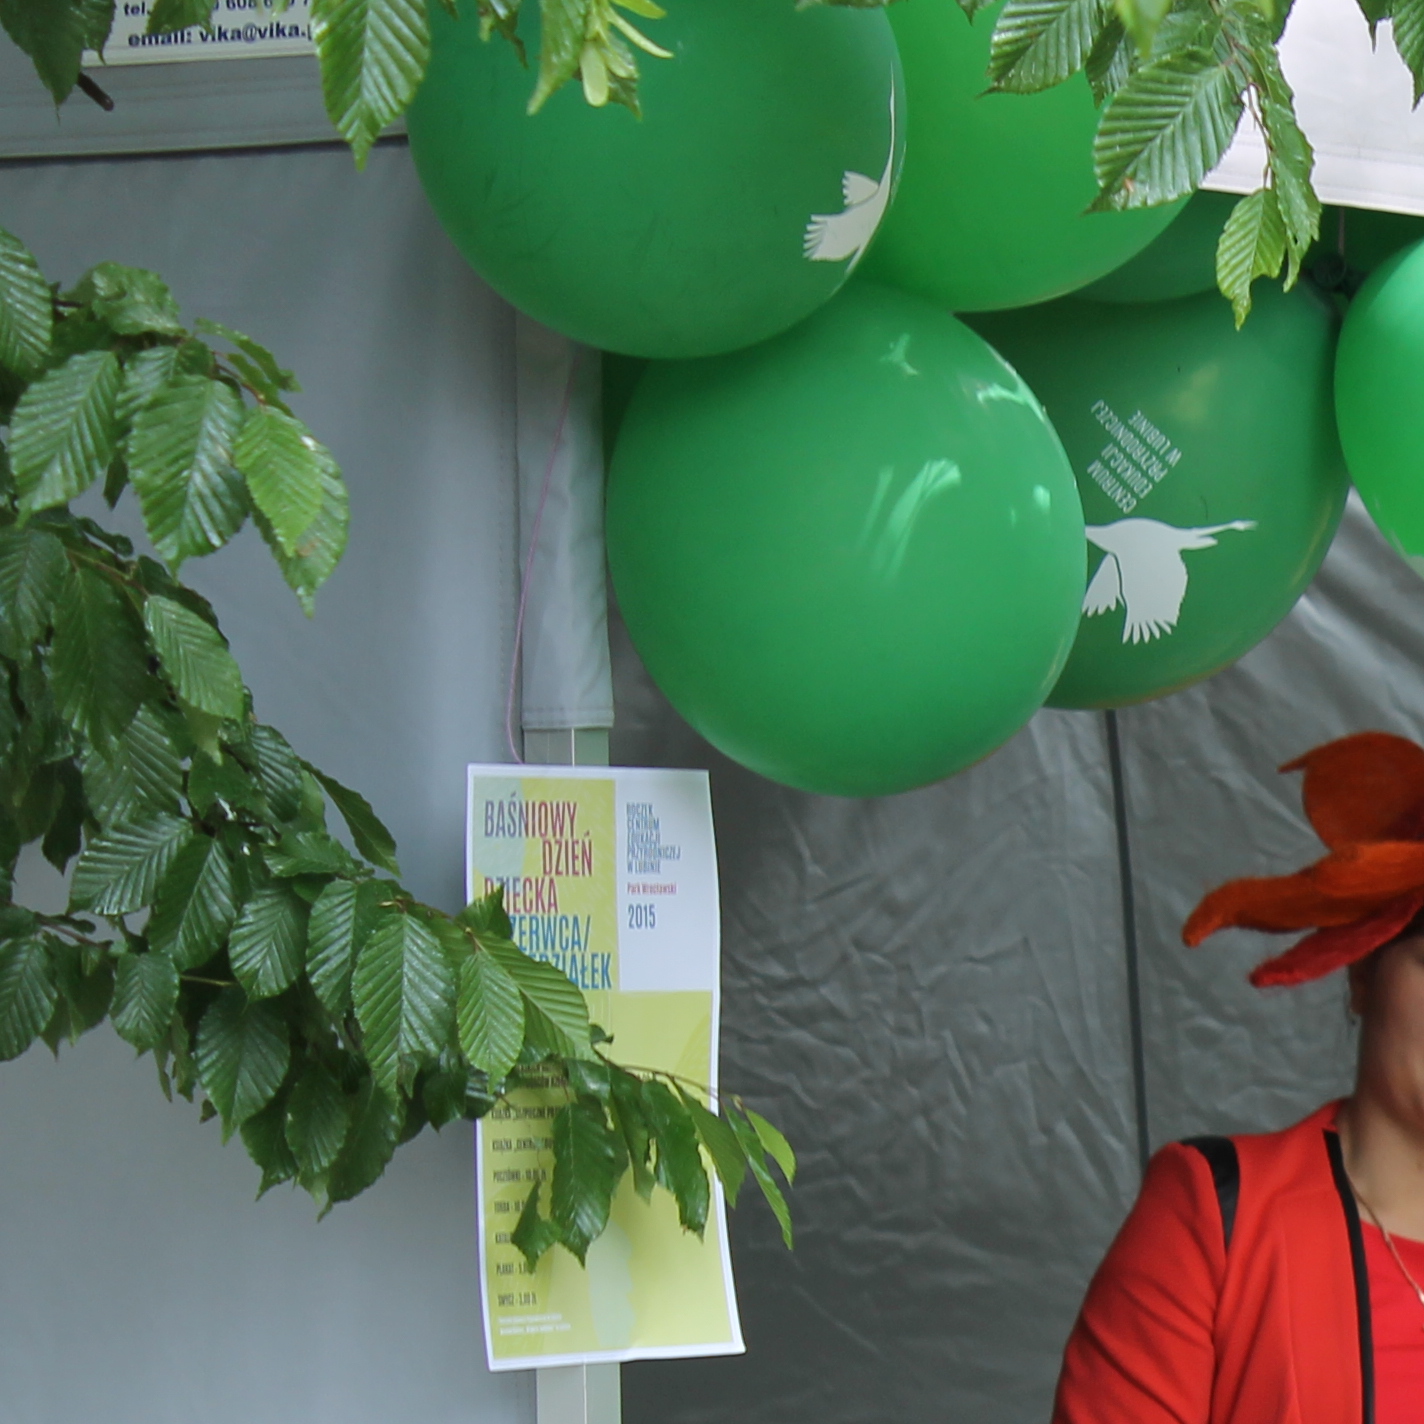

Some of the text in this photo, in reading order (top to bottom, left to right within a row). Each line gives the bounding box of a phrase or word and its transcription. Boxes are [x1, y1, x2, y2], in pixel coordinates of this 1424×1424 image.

[124, 1, 150, 17] tel.
[1101, 442, 1153, 499] EDUKACJI
[1165, 447, 1182, 468] W
[1087, 459, 1137, 514] CENTRUM
[484, 791, 577, 838] BAŚNIOWY
[542, 830, 593, 877] DZIEŃ
[484, 876, 559, 914] DIECKA
[628, 903, 656, 929] 2015
